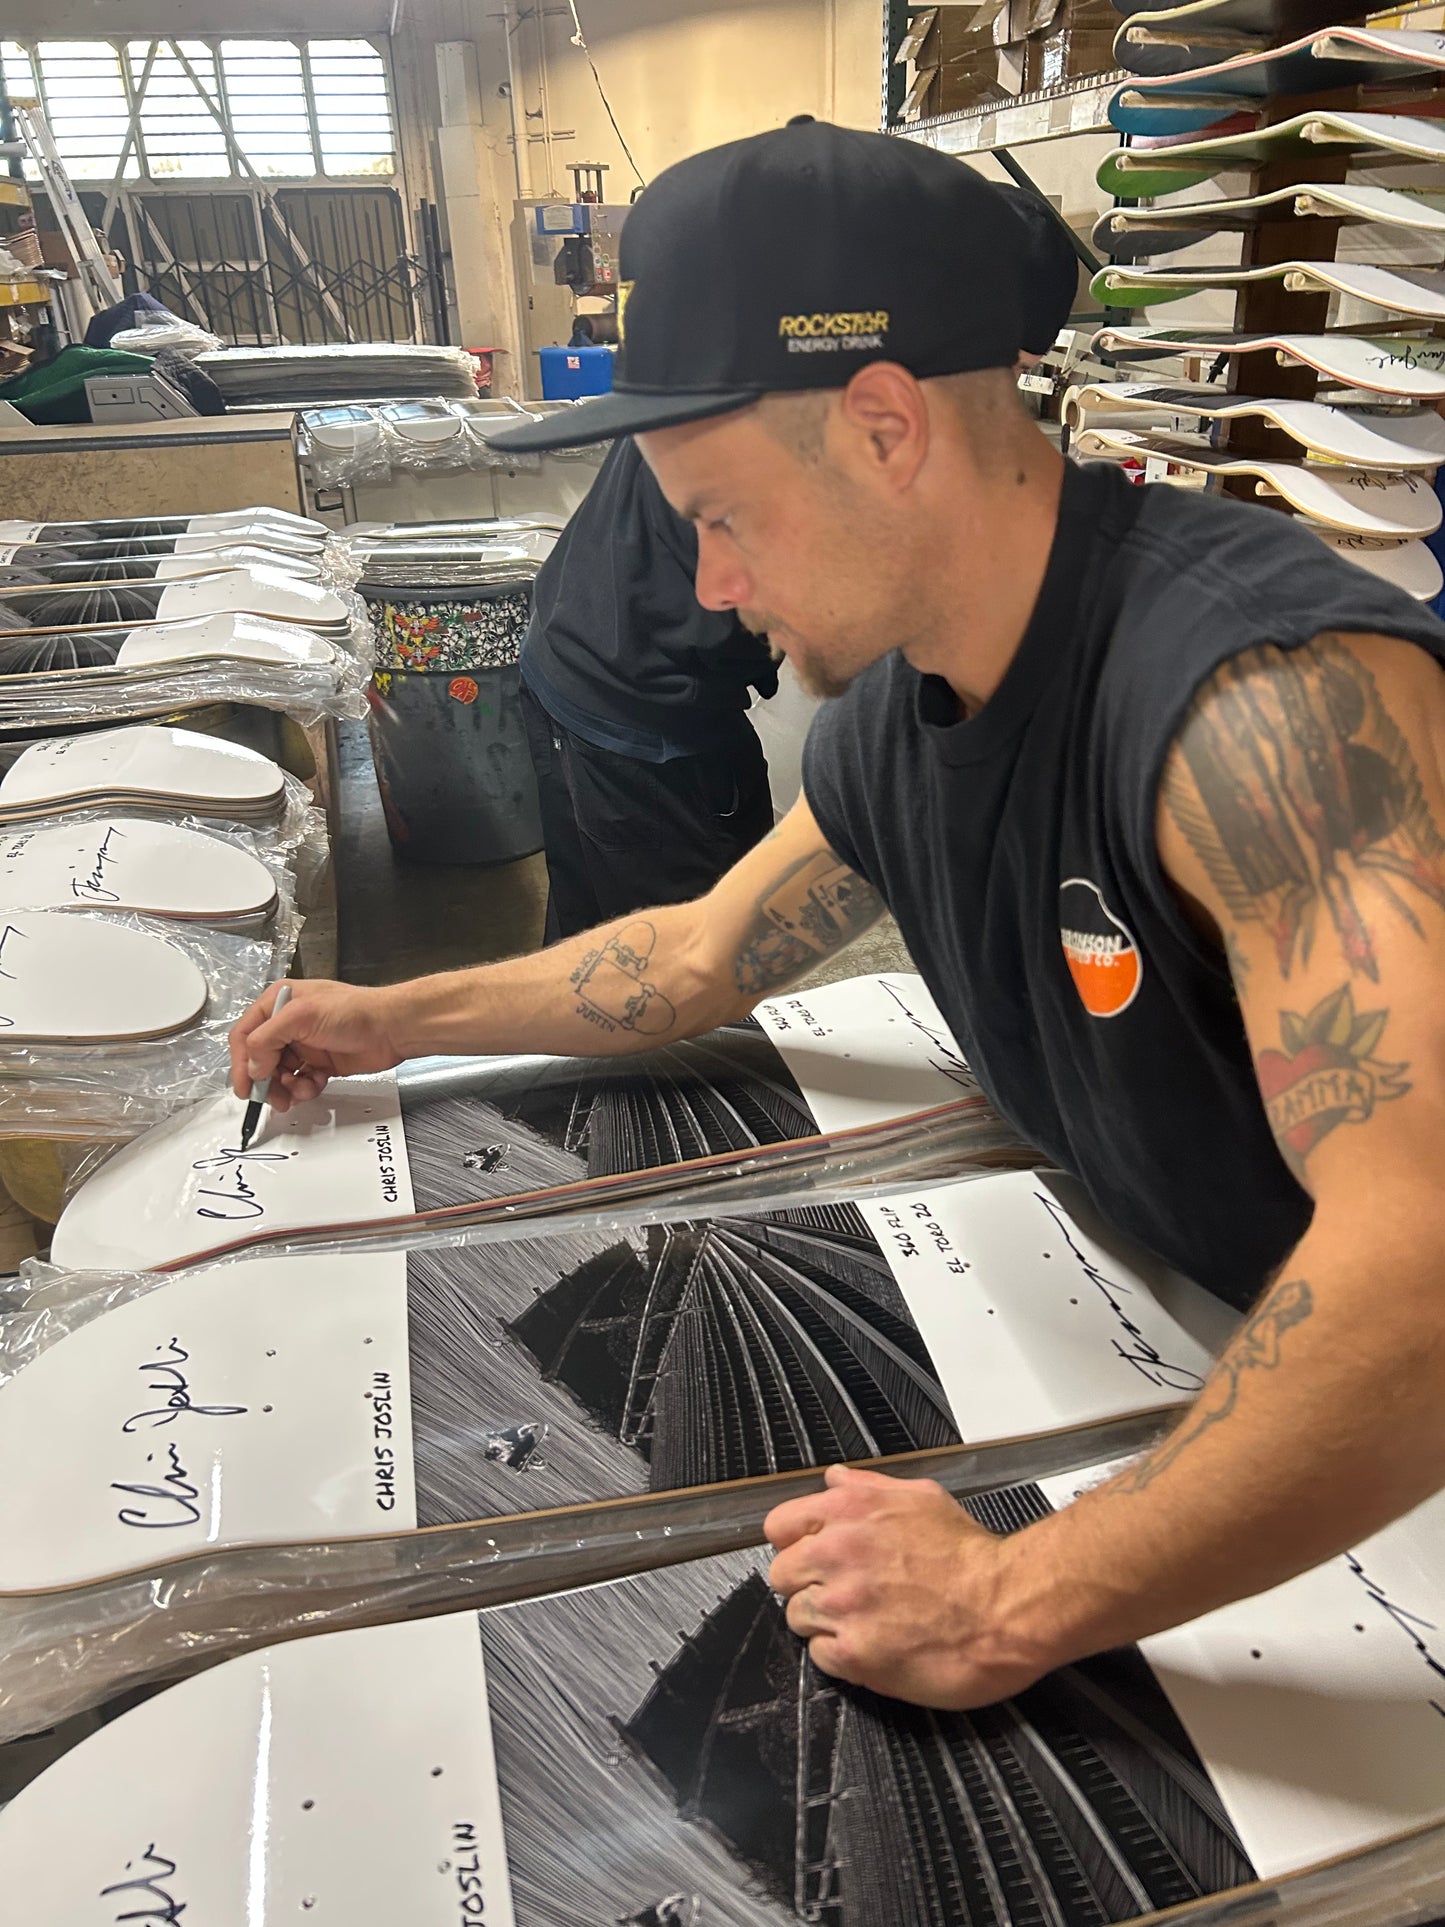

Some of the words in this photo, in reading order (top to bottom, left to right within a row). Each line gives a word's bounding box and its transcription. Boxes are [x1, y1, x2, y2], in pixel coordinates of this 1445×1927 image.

[779, 310, 888, 336] ROCKSTAR
[788, 337, 838, 353] ENERGY
[841, 335, 883, 350] DRINK
[575, 1002, 616, 1033] JUSTIN
[375, 1125, 393, 1162] JOSLIN
[379, 1165, 399, 1203] CHRIS
[880, 1207, 905, 1229] FLIP
[909, 1203, 933, 1219] 20
[893, 1233, 920, 1258] 360
[925, 1222, 954, 1253] TORO
[946, 1257, 966, 1274] EL
[372, 1372, 393, 1439] JOSLIN
[374, 1445, 395, 1510] CHRIS
